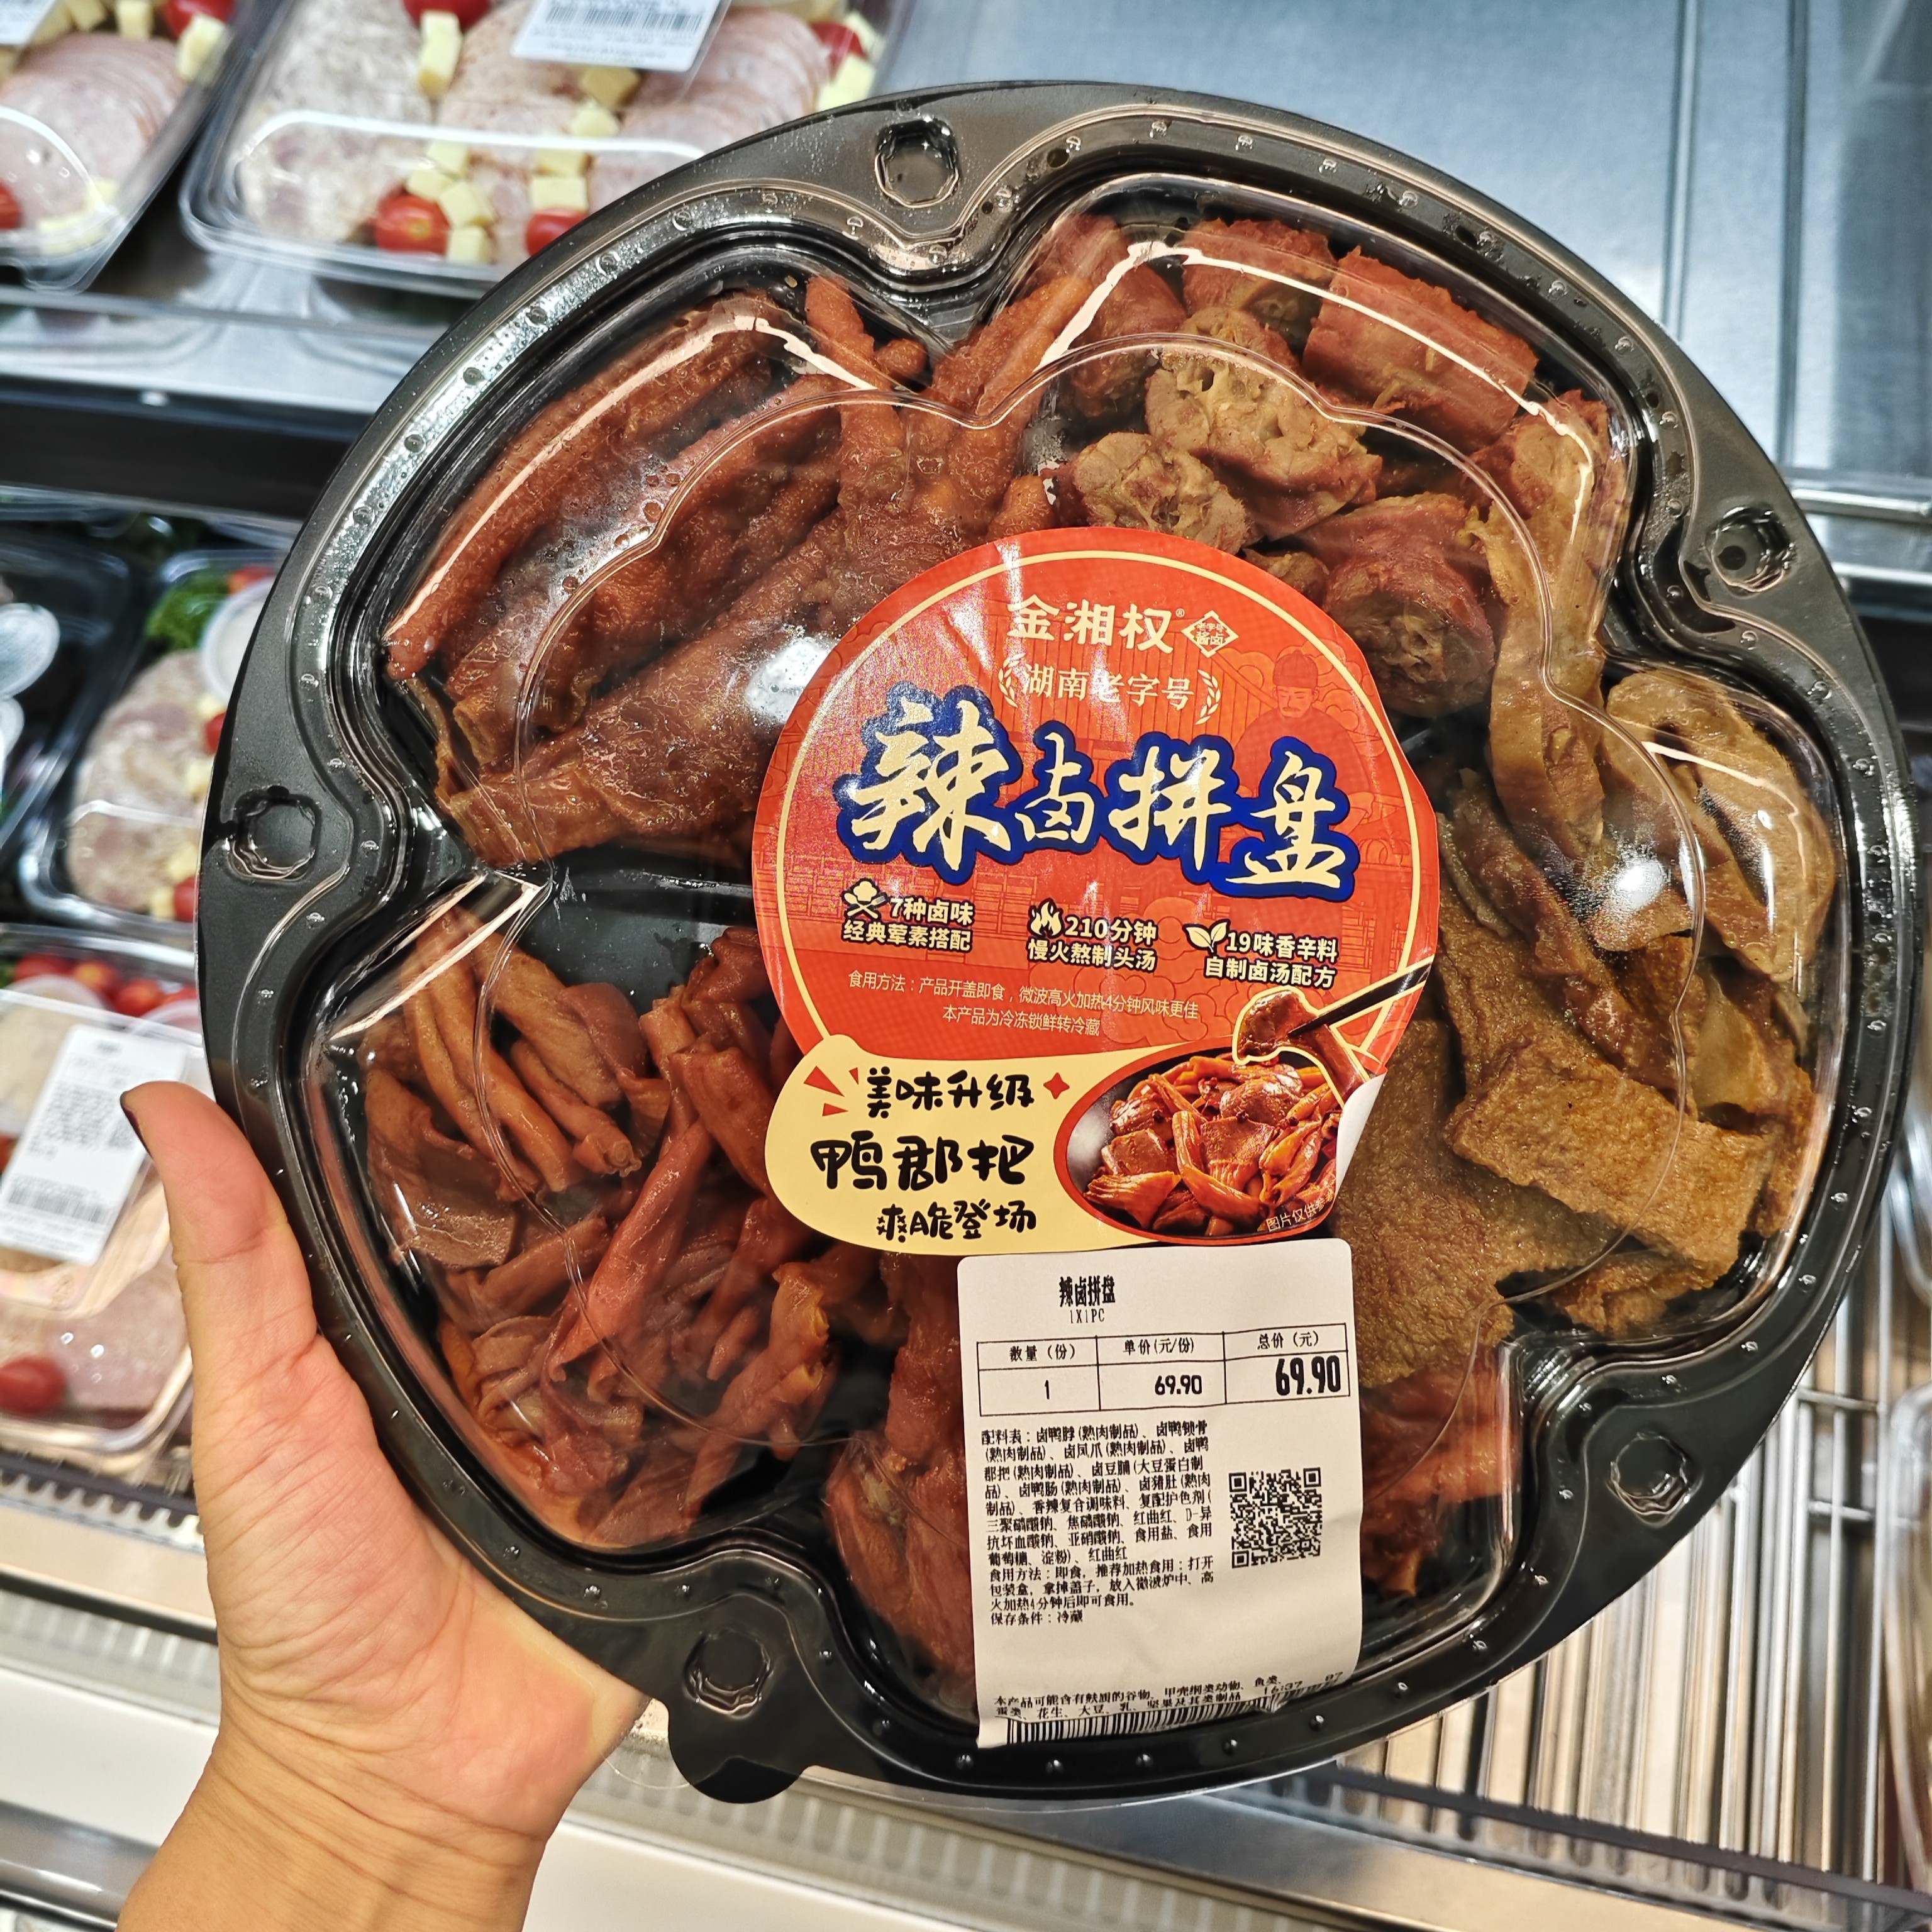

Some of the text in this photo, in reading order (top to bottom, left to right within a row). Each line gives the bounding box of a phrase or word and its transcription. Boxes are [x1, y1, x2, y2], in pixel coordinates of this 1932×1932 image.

[1007, 594, 1174, 654] 金湘权
[1023, 663, 1194, 711] 湖南老字号
[851, 698, 1345, 889] 辣卤拼盘
[890, 897, 974, 925] 7种卤味
[843, 920, 972, 952] 经典荤素搭配
[1065, 918, 1157, 945] 210分钟
[1227, 931, 1337, 963] 19味香辛料
[1028, 940, 1157, 970] 慢火熬制头汤
[1206, 955, 1336, 988] 自制卤汤配方
[943, 1006, 1099, 1036] 本产品为冷冻锁鲜转冷藏
[867, 1067, 1035, 1118] 美味升级
[811, 1130, 1035, 1191] 鸭郡把
[876, 1198, 1036, 1243] 爽脆登场
[1059, 1275, 1115, 1307] 辣卤拼盘
[1070, 1308, 1105, 1323] 1X1PC
[1044, 1380, 1050, 1399] 1
[1155, 1375, 1202, 1396] 69.90
[1275, 1355, 1341, 1396] 69.90
